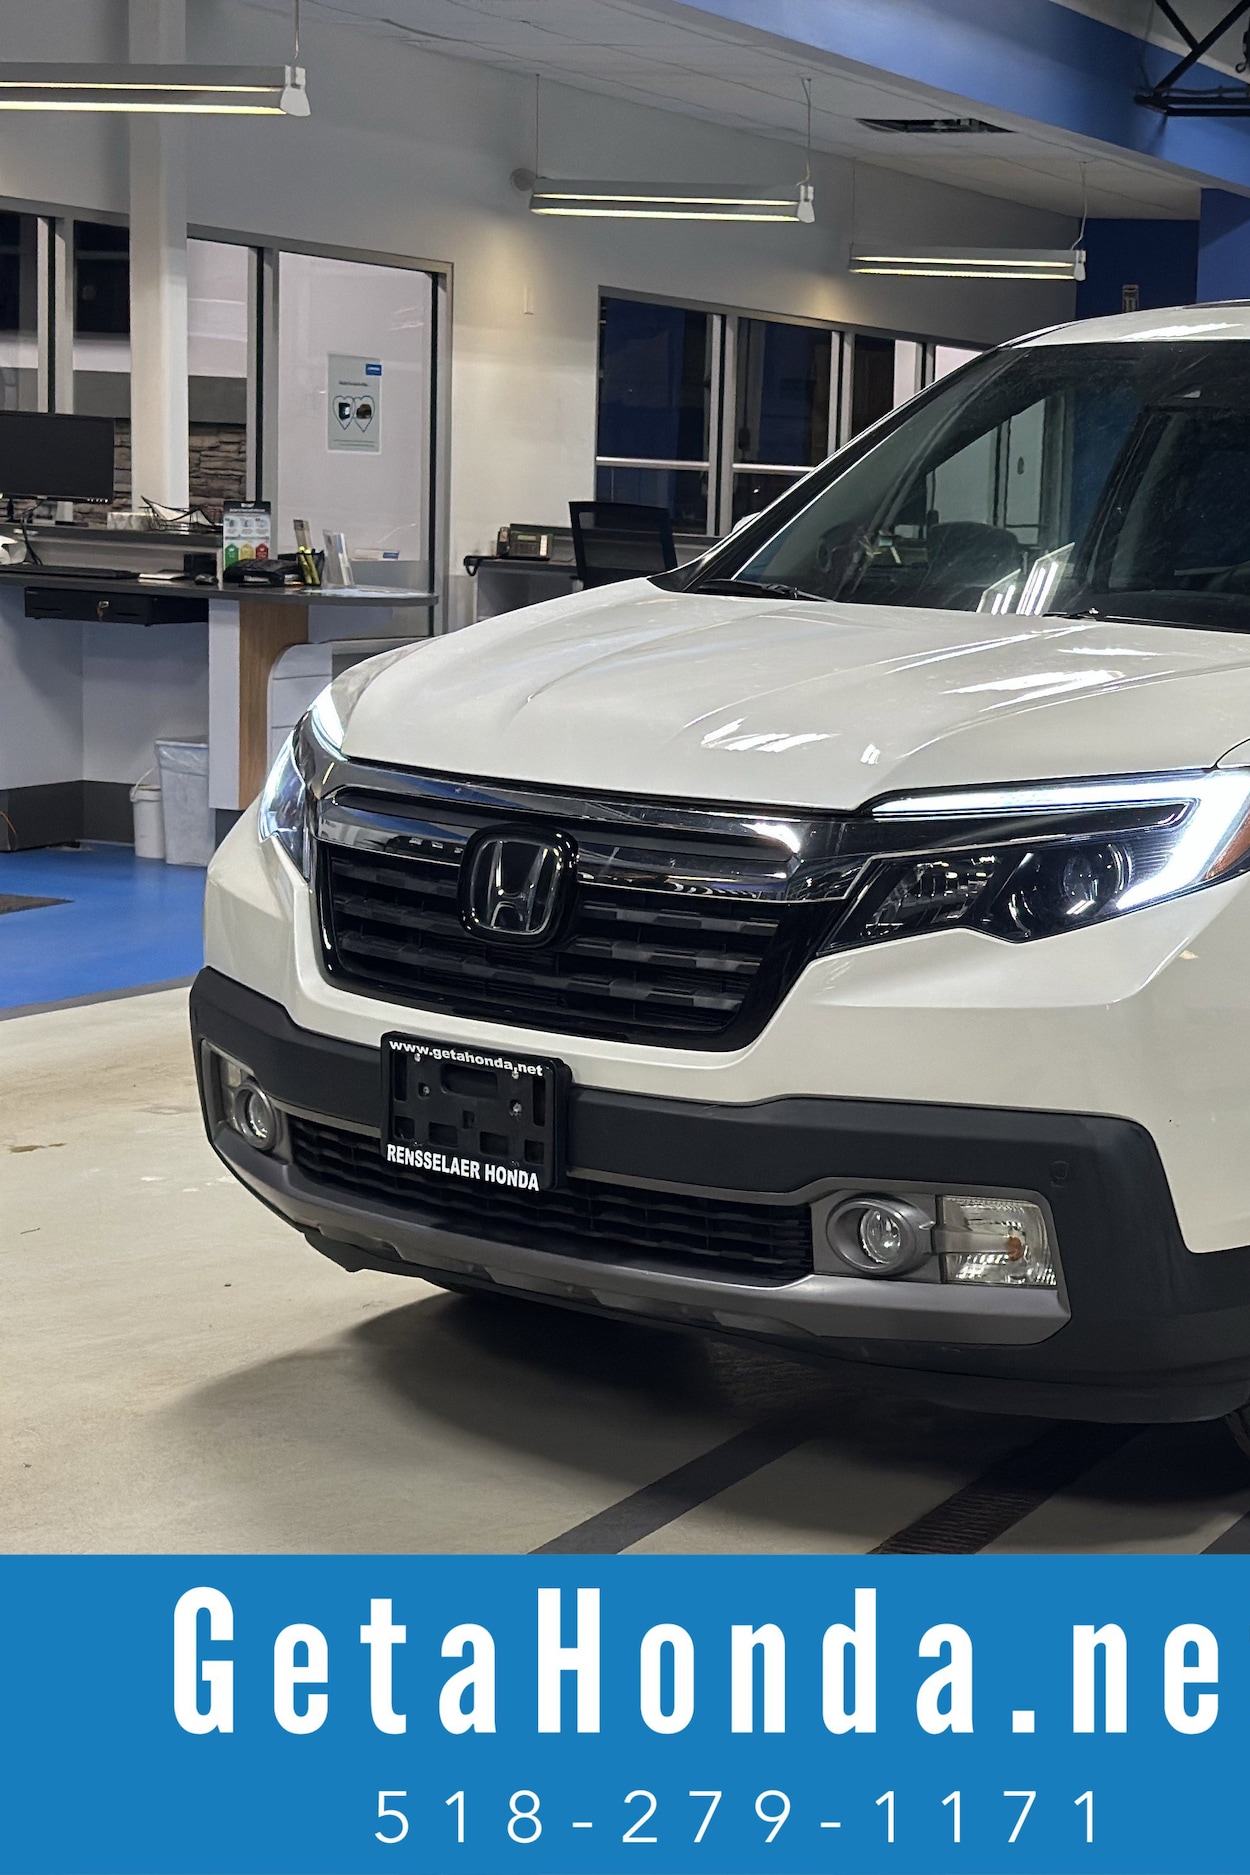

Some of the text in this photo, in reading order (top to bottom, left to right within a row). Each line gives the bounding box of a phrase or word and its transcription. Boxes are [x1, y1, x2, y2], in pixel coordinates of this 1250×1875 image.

[389, 1040, 543, 1077] www.getahonda.net
[386, 1143, 540, 1192] RENSSELAER HONDA
